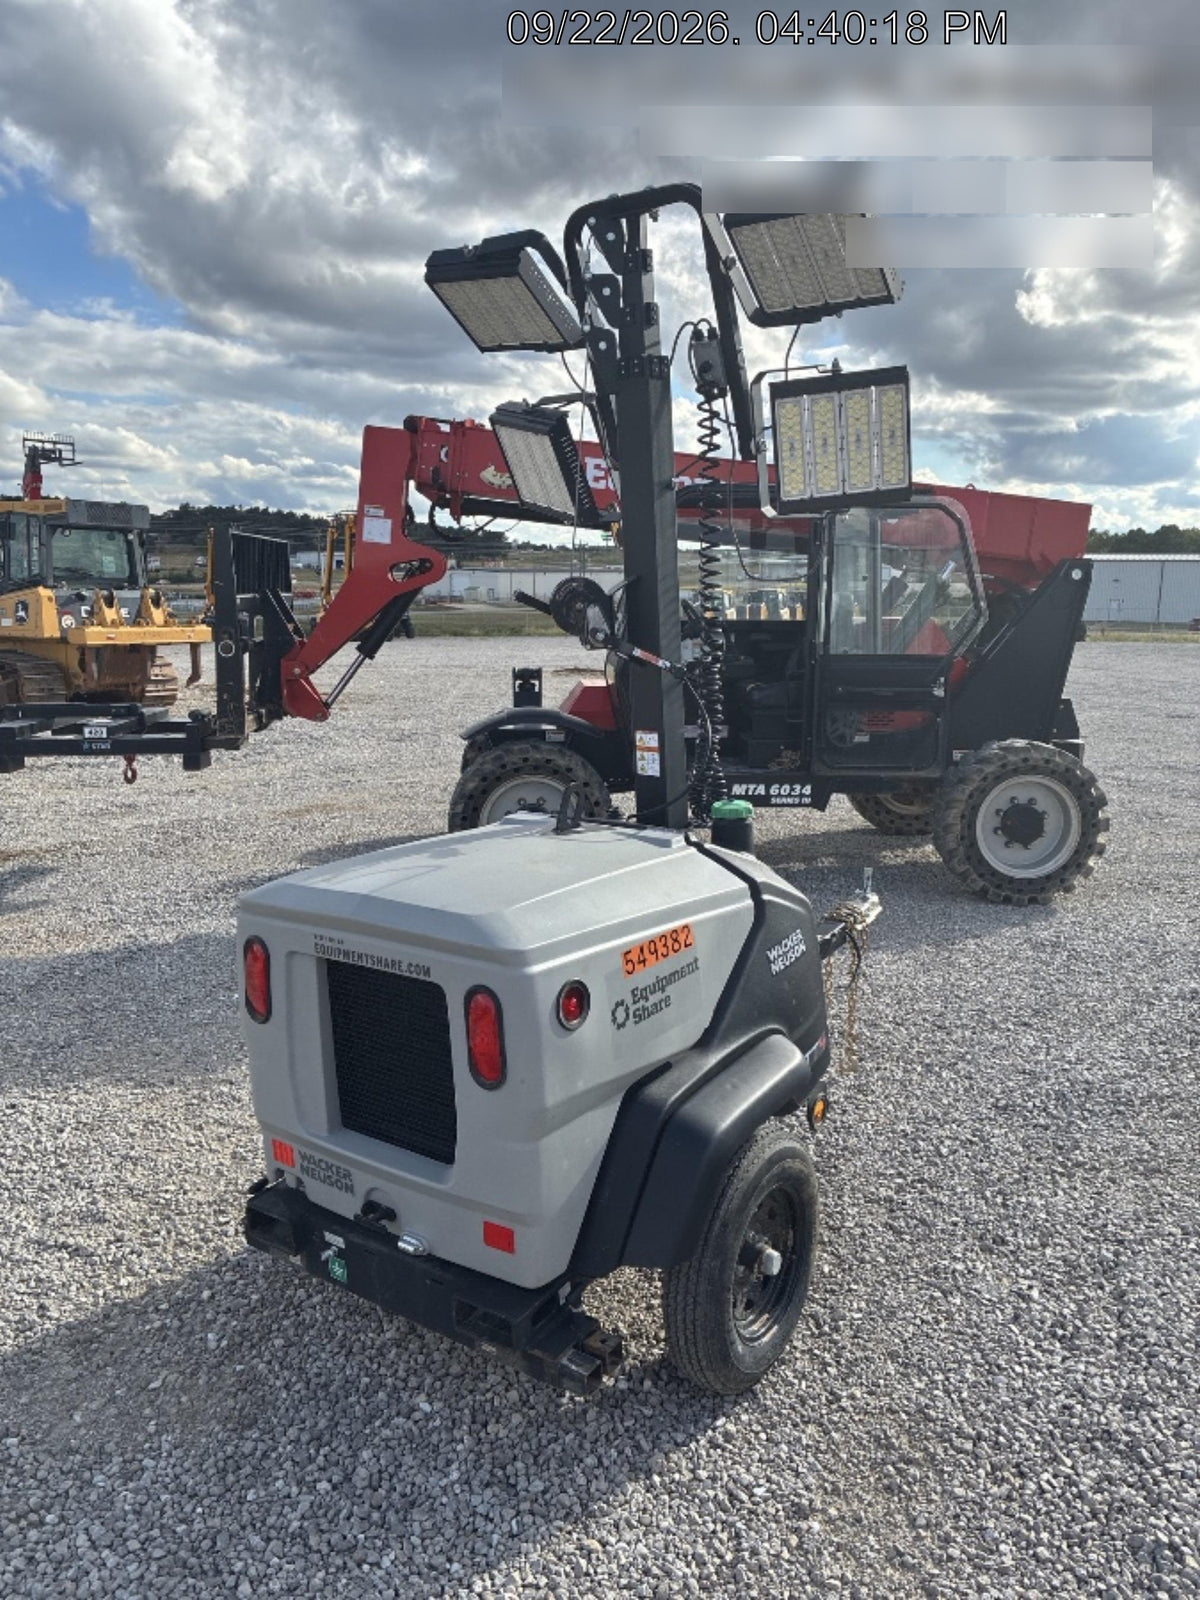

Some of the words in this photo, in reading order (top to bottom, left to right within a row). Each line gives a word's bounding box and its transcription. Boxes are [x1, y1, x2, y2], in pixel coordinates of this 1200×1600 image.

[731, 783, 766, 796] MTA
[769, 783, 812, 796] 6034
[313, 942, 431, 979] EQUIPMENTSHARE.COM
[623, 924, 694, 975] 549382
[766, 929, 804, 961] WACKER
[770, 943, 807, 976] NEUSON
[630, 956, 700, 1005] Equipment
[632, 994, 672, 1026] Share
[299, 1150, 353, 1183] WACKER
[301, 1164, 356, 1197] NEUSON
